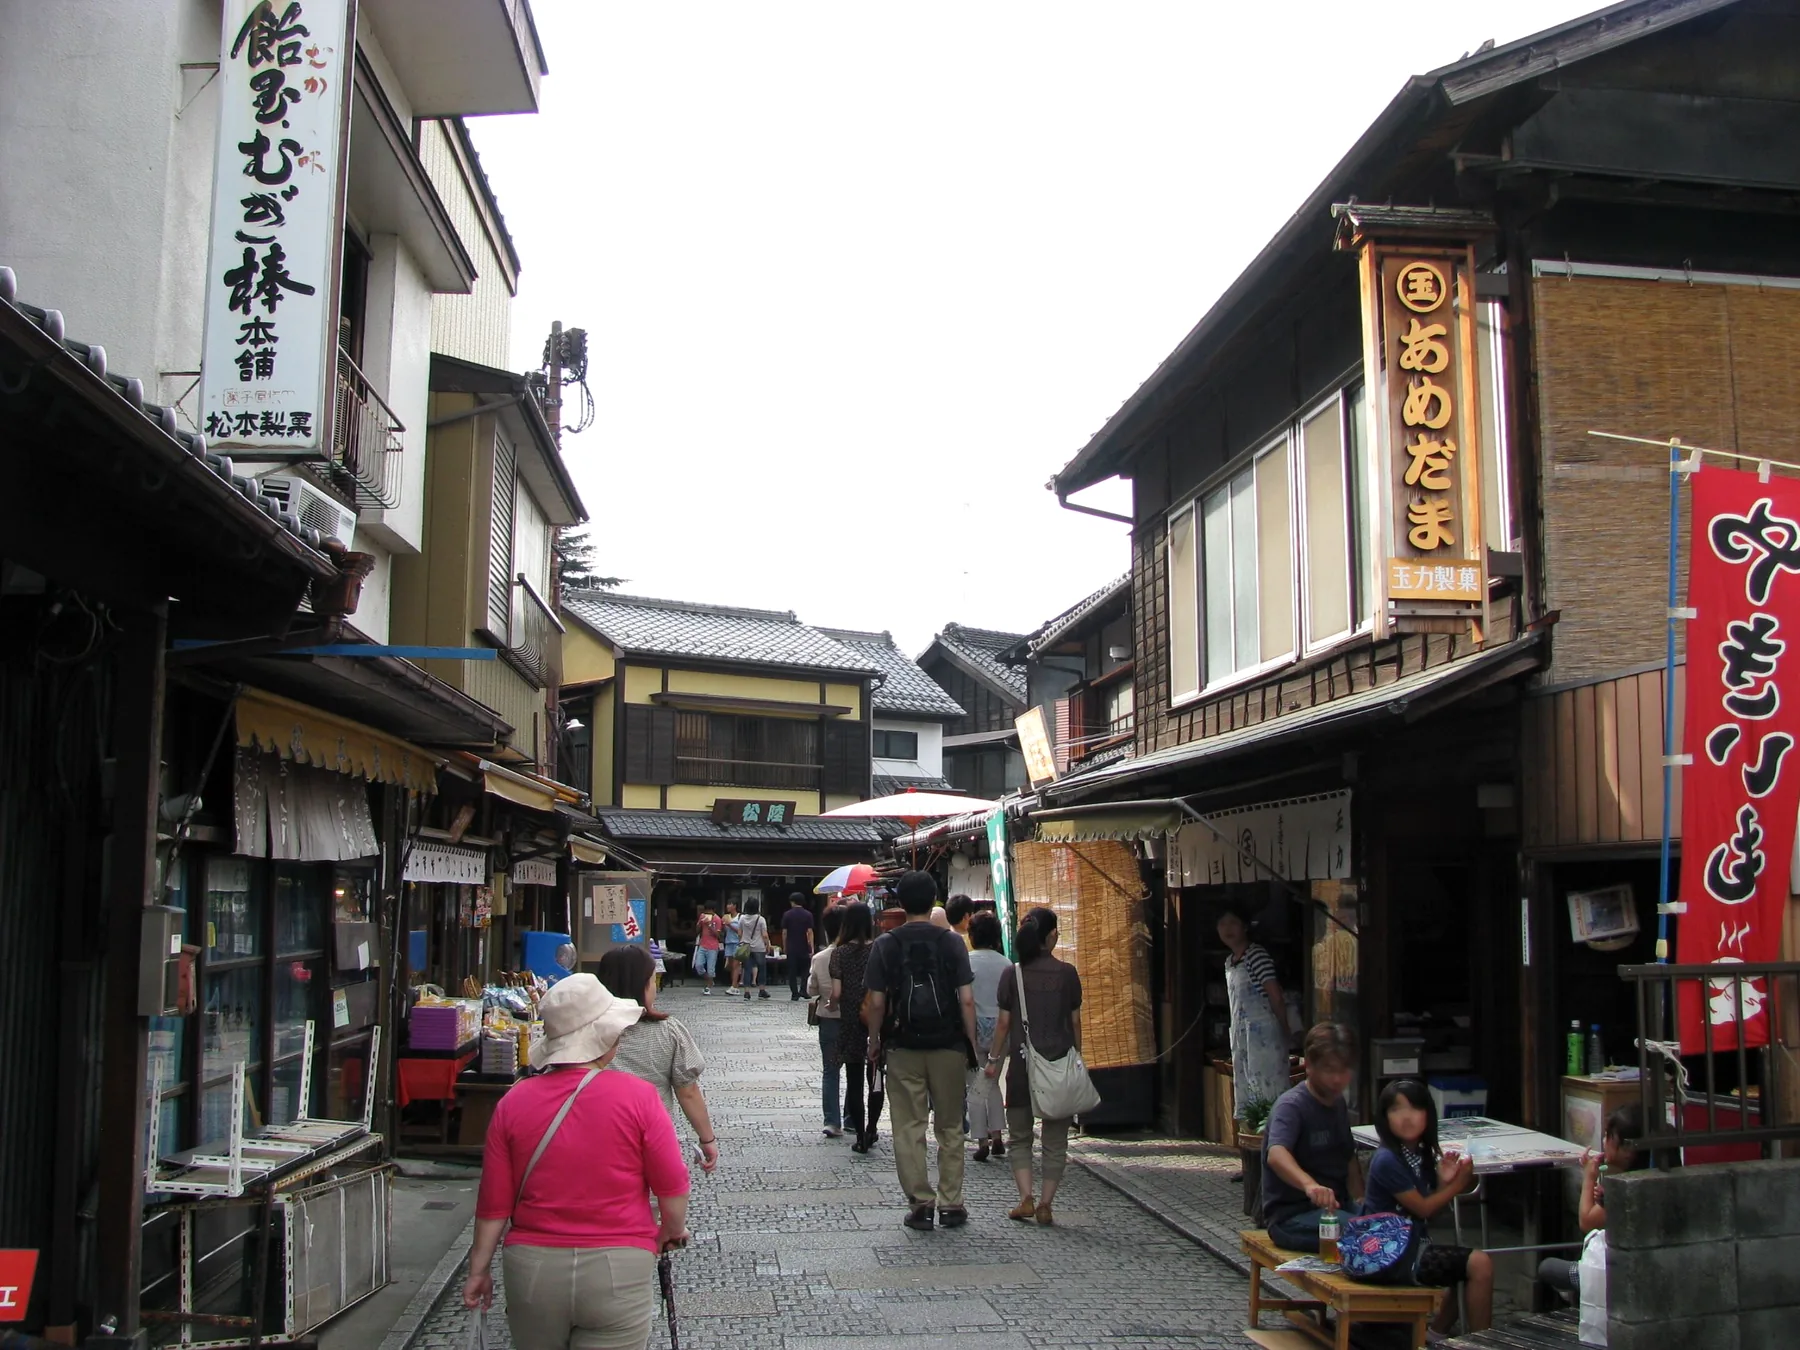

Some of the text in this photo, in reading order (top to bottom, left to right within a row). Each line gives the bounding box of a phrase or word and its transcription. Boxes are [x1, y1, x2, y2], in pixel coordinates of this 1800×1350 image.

[1399, 318, 1456, 550] あめだま
[1391, 565, 1478, 593] 玉力製菓
